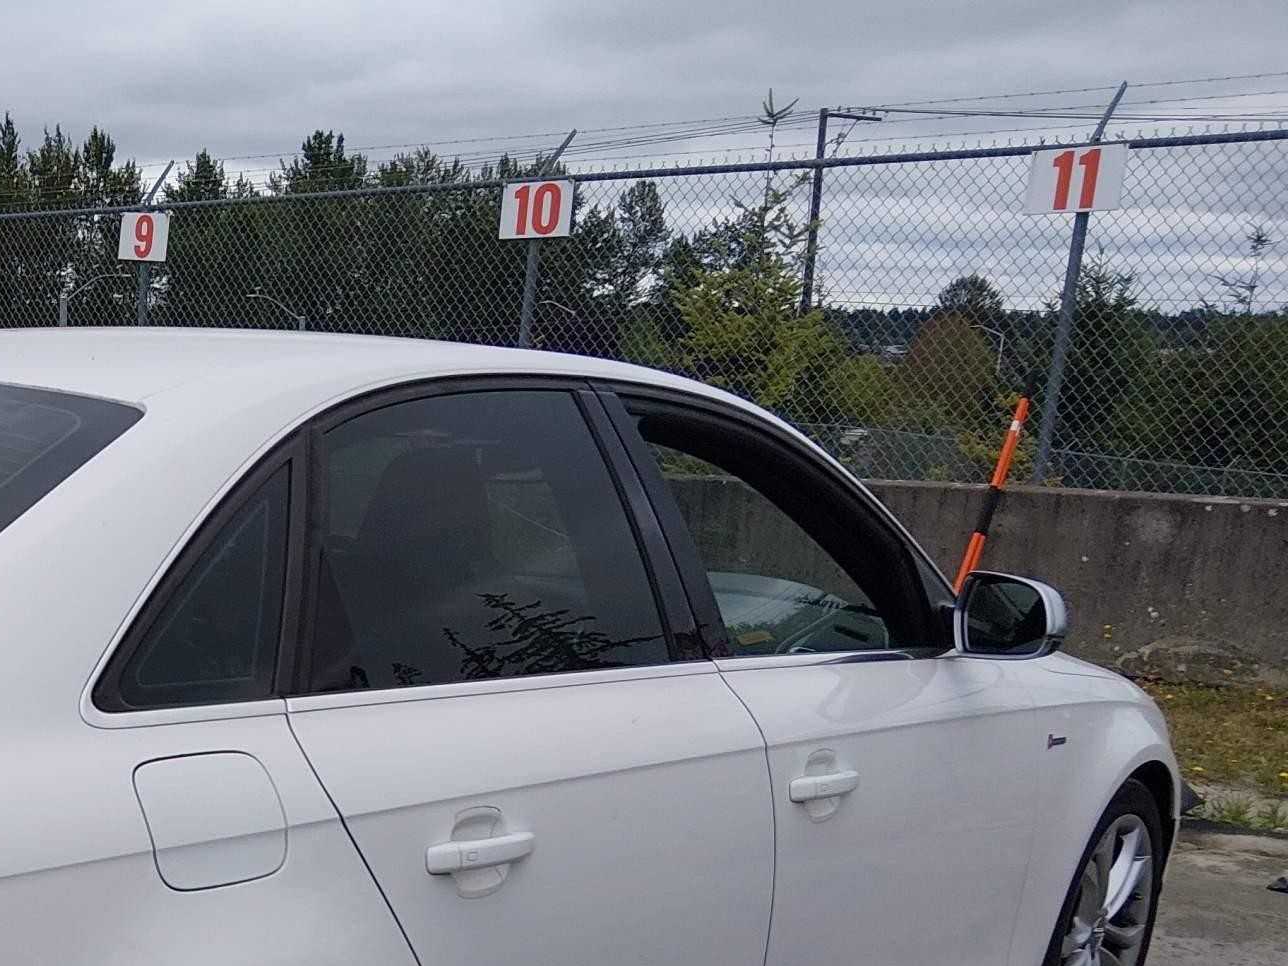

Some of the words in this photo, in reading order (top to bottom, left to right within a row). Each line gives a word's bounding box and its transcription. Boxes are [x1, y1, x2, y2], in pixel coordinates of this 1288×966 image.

[1052, 148, 1102, 210] 11
[514, 183, 562, 236] 10
[134, 214, 154, 259] 9
